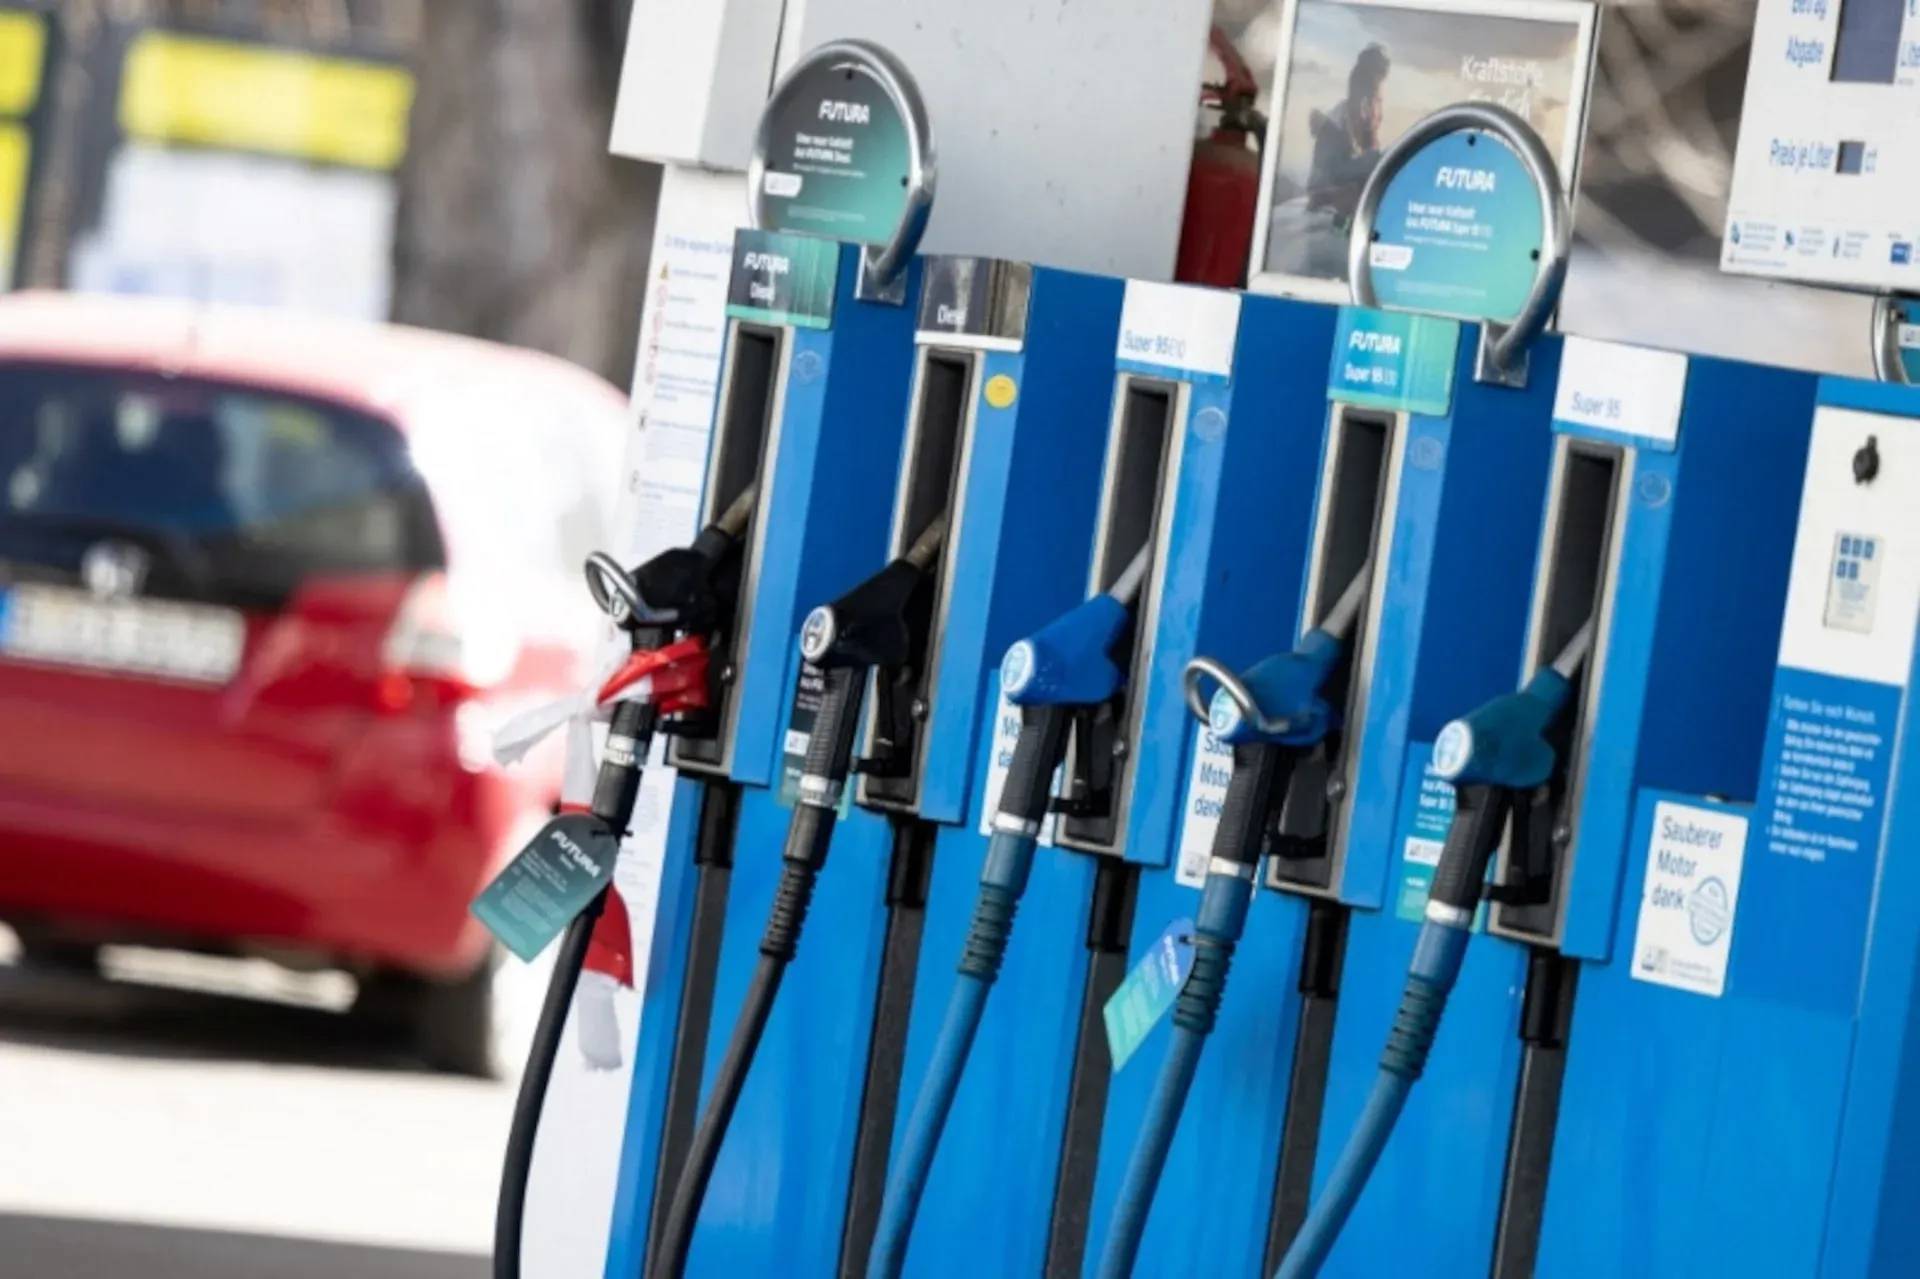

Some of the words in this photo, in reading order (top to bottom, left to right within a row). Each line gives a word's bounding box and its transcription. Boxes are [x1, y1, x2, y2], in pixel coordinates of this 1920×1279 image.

[818, 100, 870, 124] FUTURA
[1436, 166, 1496, 192] FUTURA
[743, 252, 789, 275] FUTURA
[937, 304, 968, 325] Diesel
[1124, 329, 1154, 353] Super
[1349, 329, 1401, 355] FUTURA
[1344, 362, 1371, 383] Super
[1571, 391, 1604, 416] Super
[1606, 398, 1621, 419] 95
[1661, 815, 1723, 850] Sauberer
[551, 829, 601, 878] FUTURA
[1657, 850, 1697, 878] Motor
[1652, 882, 1684, 909] dank
